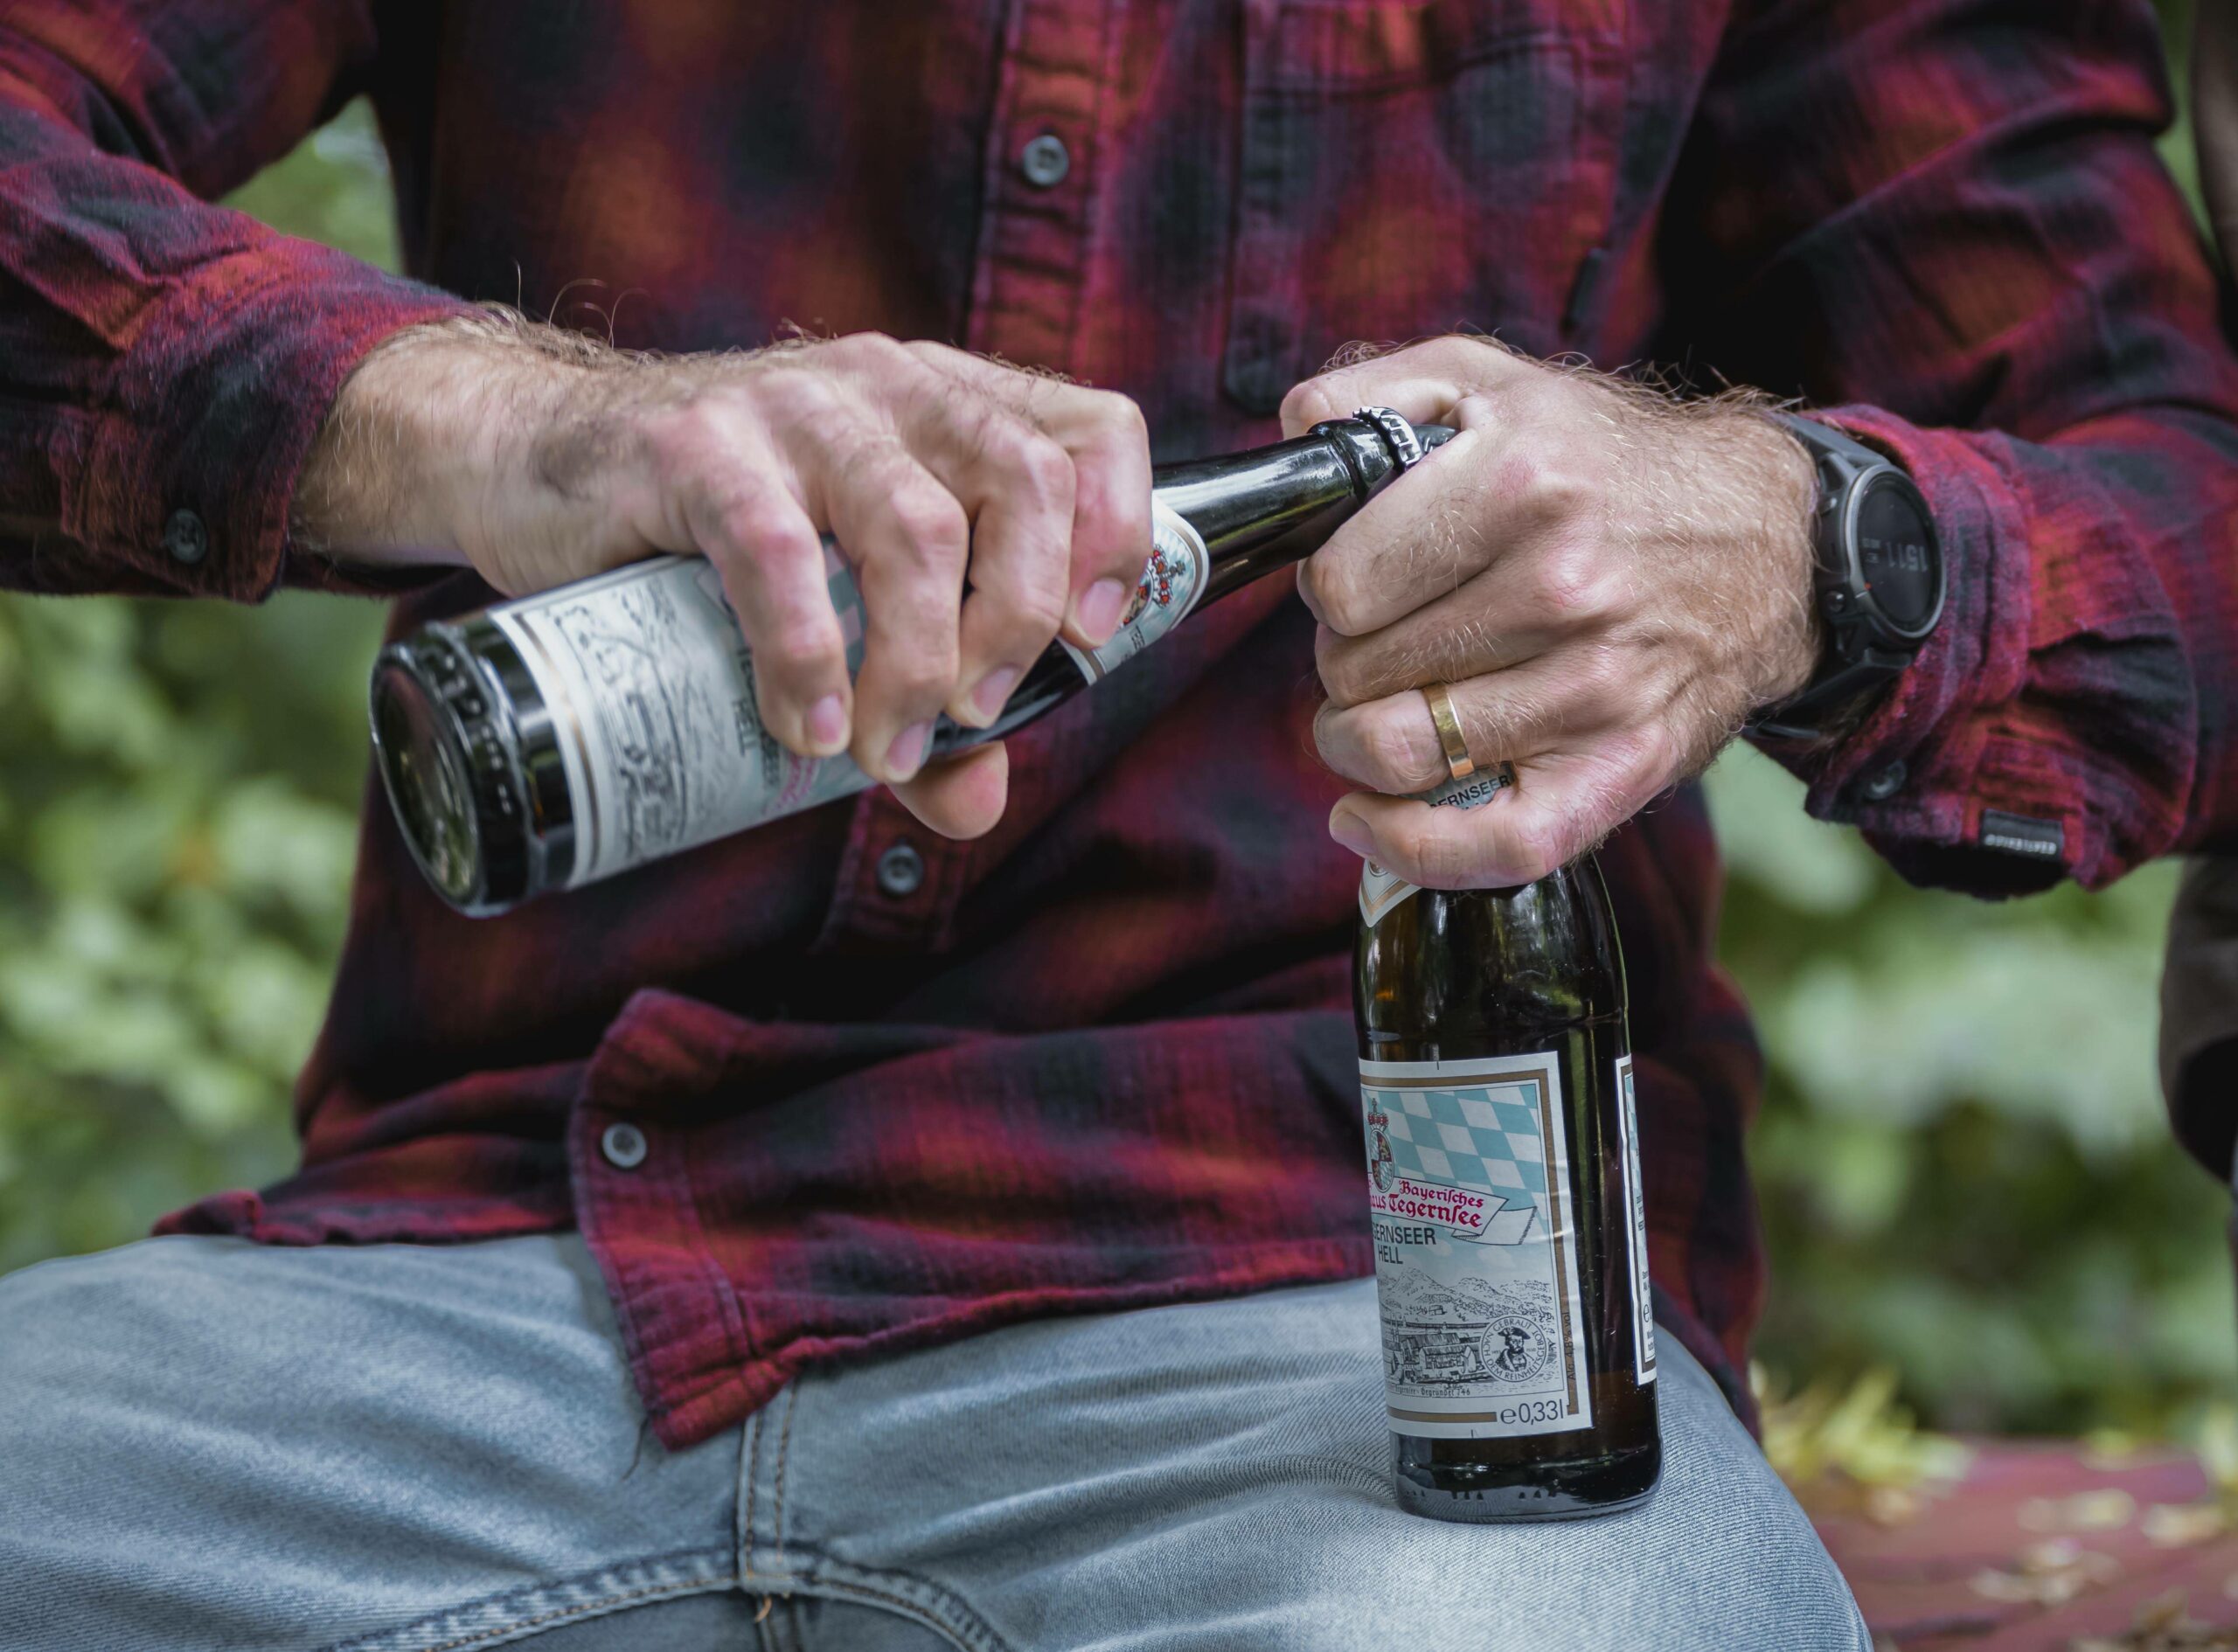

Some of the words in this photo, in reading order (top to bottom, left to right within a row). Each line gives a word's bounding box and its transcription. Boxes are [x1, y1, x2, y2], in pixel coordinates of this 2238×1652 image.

[1377, 1243, 1404, 1265] HELL
[1492, 1317, 1533, 1332] GEBRAUT
[1560, 1312, 1572, 1328] vol
[1484, 1330, 1495, 1357] NACH
[1504, 1329, 1545, 1380] REINHEITSGEBOT
[1486, 1358, 1504, 1377] DEM
[1456, 1387, 1471, 1397] 746
